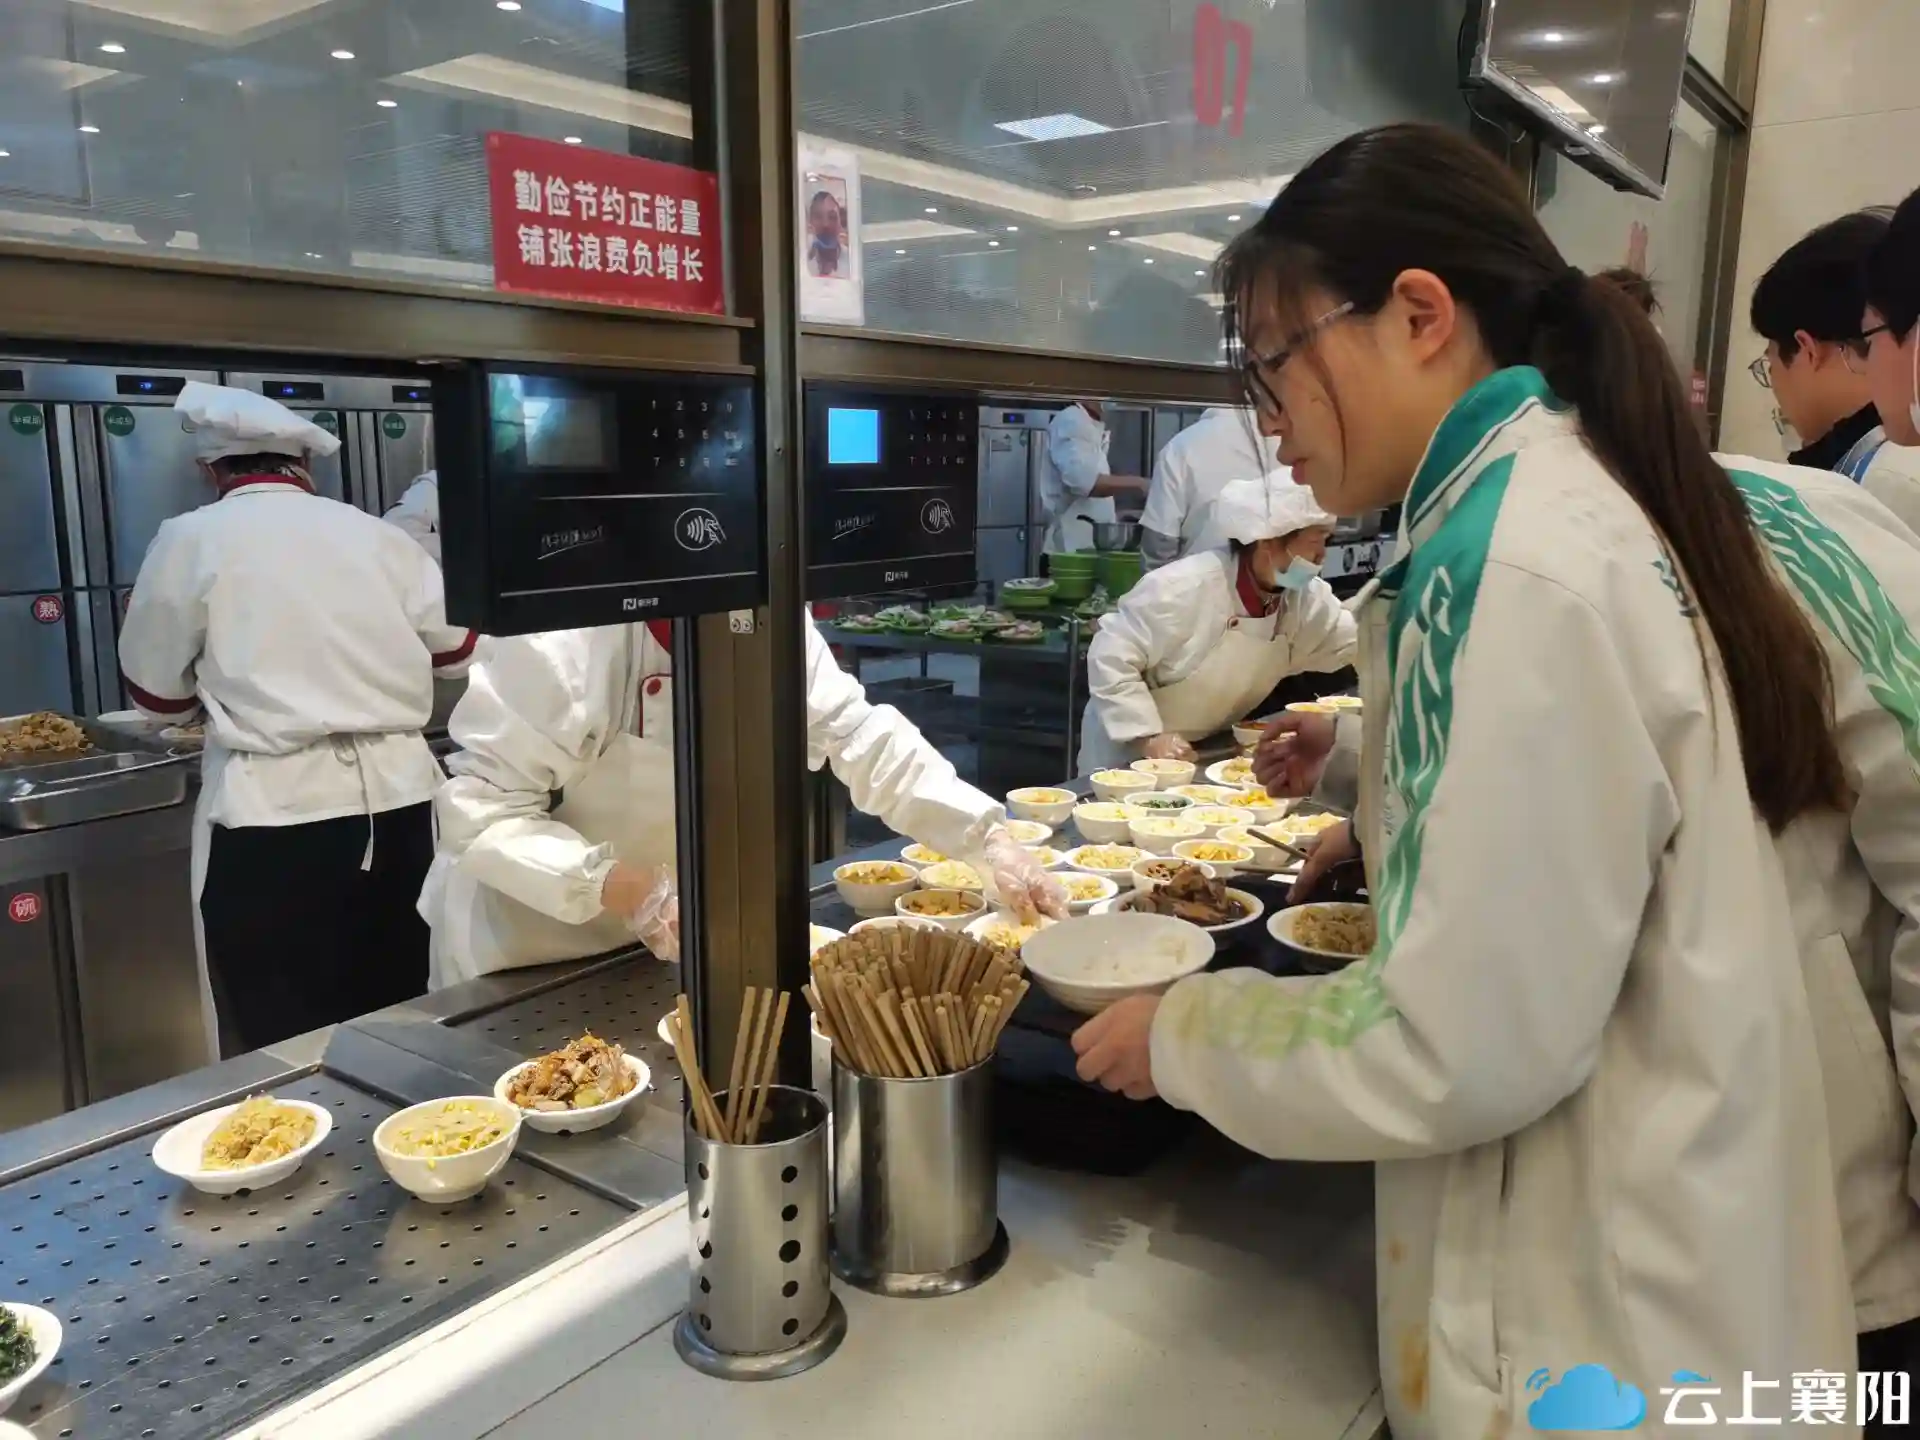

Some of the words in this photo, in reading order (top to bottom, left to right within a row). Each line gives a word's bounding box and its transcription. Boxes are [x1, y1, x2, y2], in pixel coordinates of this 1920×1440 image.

[512, 168, 702, 238] 勤俭节约正能量
[517, 223, 704, 283] 铺张浪费负增长
